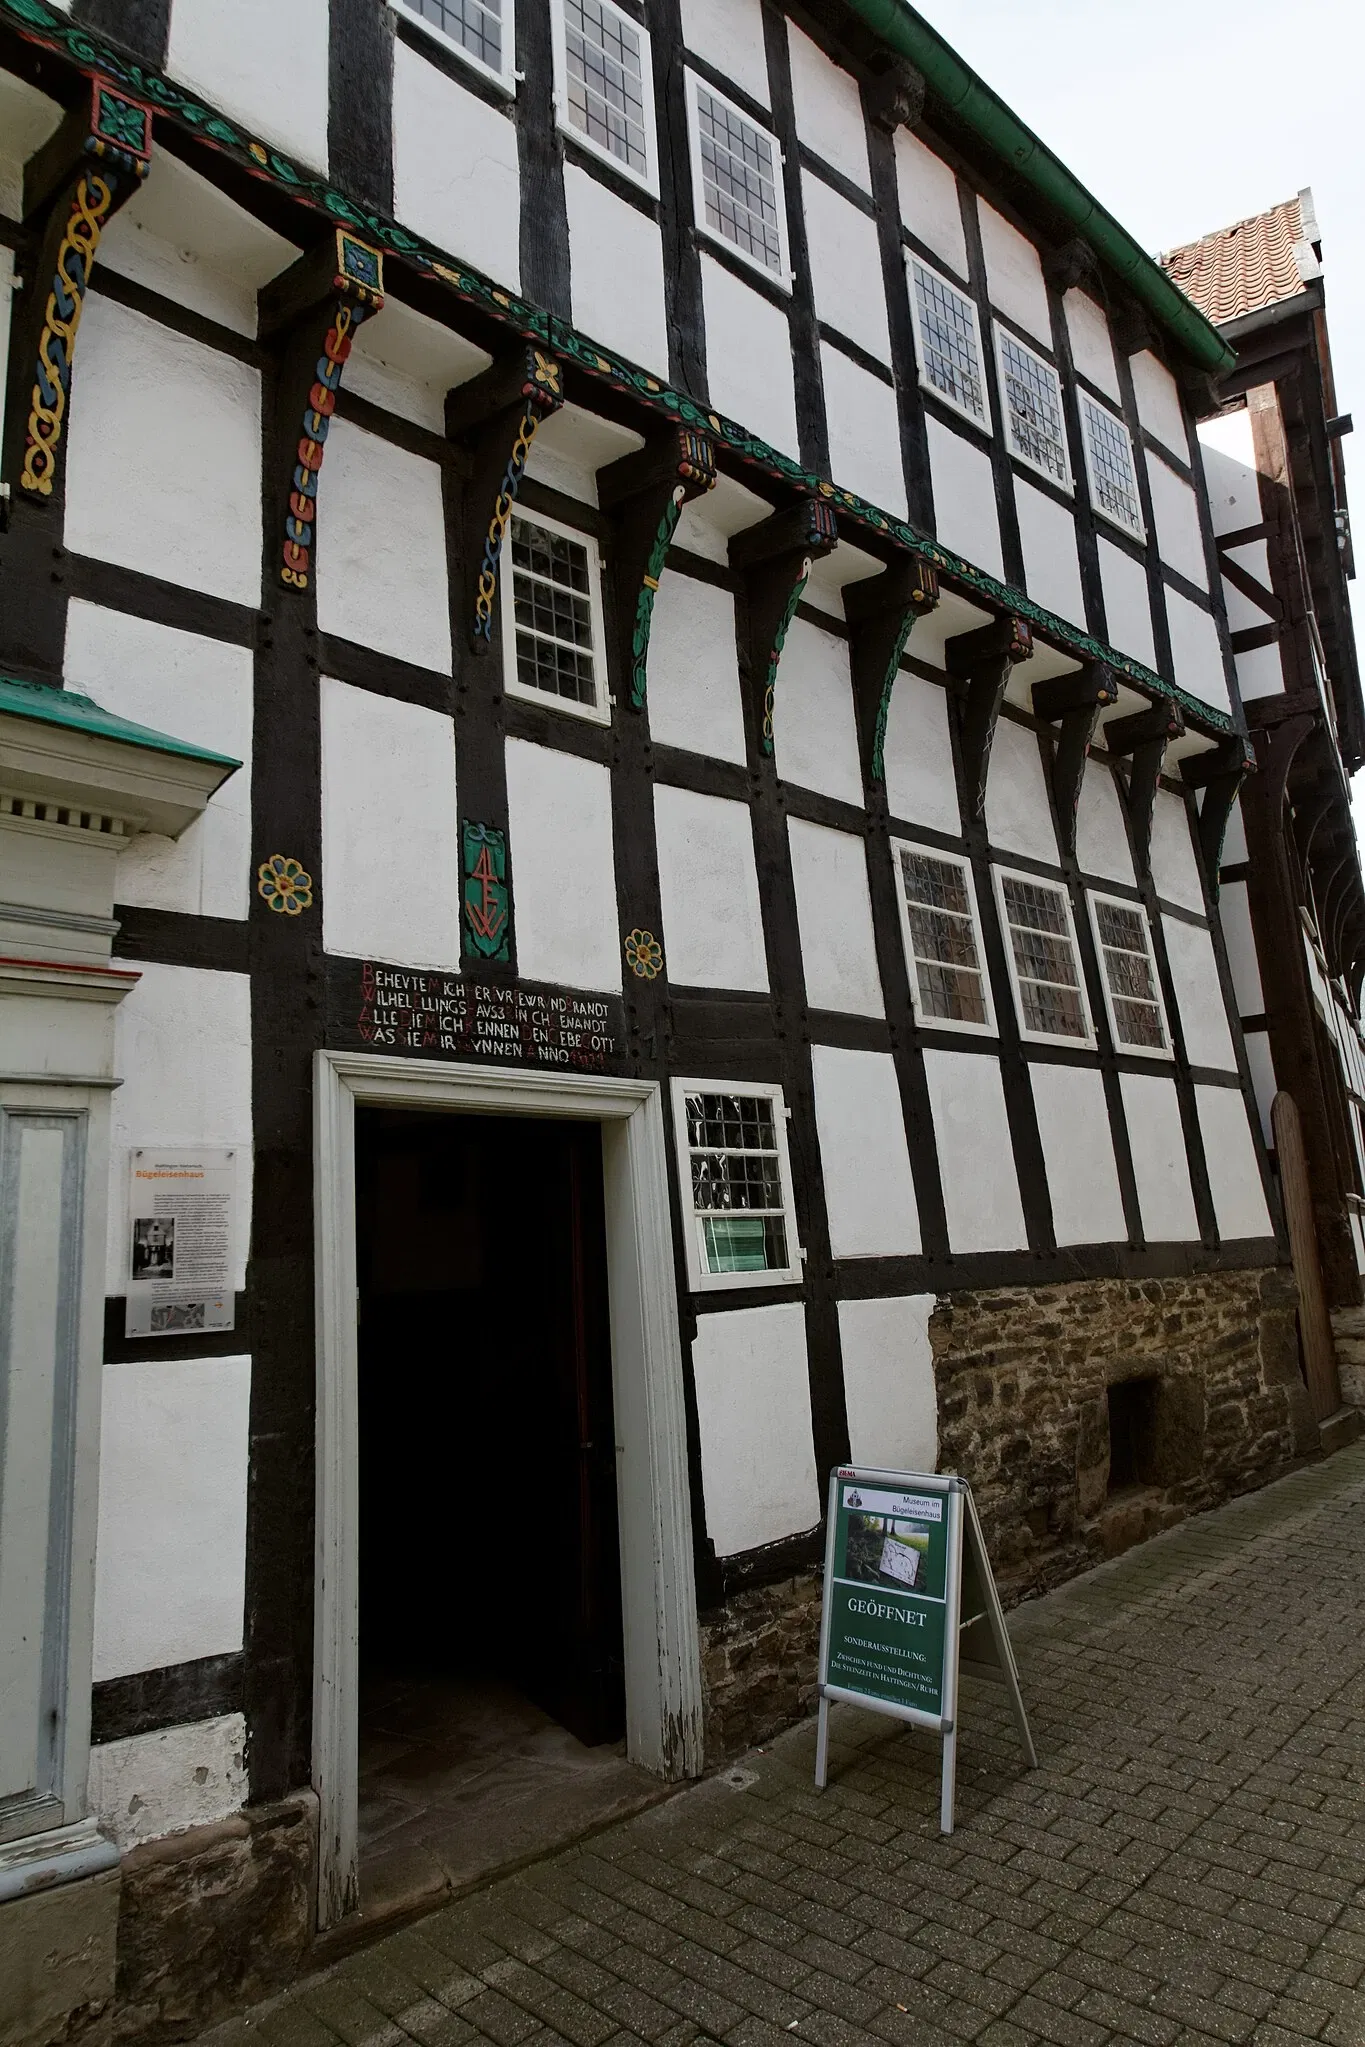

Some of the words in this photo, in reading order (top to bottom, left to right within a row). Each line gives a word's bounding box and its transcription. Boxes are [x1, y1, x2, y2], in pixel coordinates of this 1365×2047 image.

[136, 1170, 204, 1180] Bügeleisenhaus
[903, 1496, 930, 1507] Museum
[932, 1500, 940, 1508] im
[892, 1505, 941, 1519] Bügeleisenhaus
[847, 1597, 927, 1627] GEÖFFNET
[843, 1635, 927, 1662] SONDERAUSSTELLUNG:
